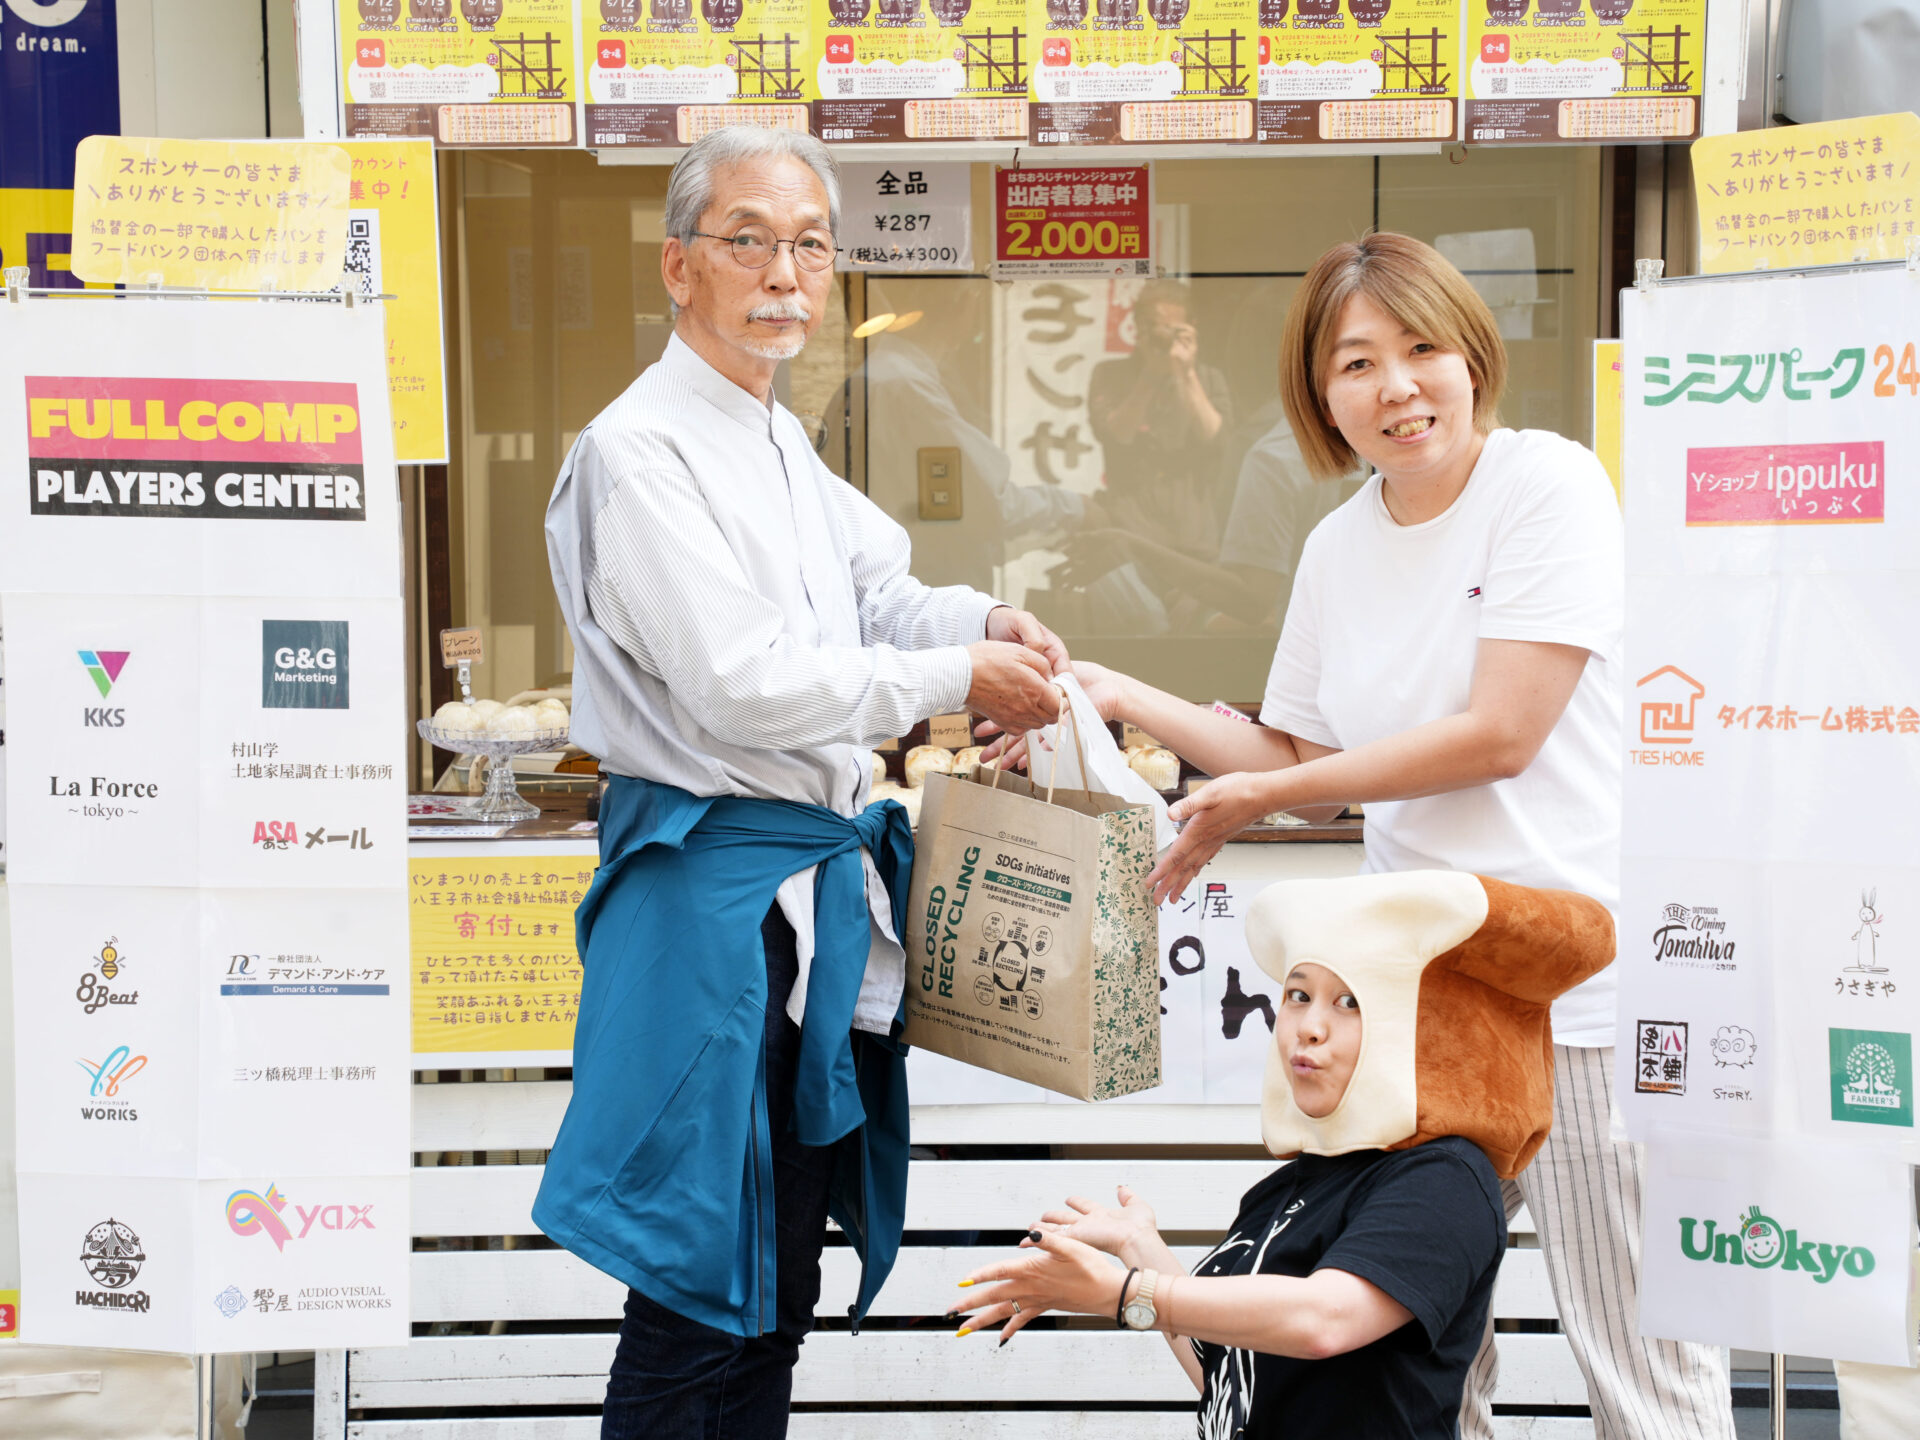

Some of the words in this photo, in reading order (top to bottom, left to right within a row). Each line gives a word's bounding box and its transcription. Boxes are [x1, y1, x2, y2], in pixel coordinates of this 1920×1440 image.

[16, 32, 86, 53] dream.
[1731, 136, 1883, 168] スポンサーの皆さま
[119, 158, 302, 183] スポンサーの皆さま
[1008, 171, 1136, 182] はちおうじチャレンジショップ
[876, 170, 928, 195] 全品
[1007, 184, 1137, 206] 出店者募集中
[874, 214, 931, 232] ¥287
[1716, 198, 1913, 231] 協賛金の一部で購入したパンを
[90, 219, 328, 244] 協賛金の一部で購入したパンを
[1719, 221, 1914, 250] フードバンク団体へ寄付します
[90, 242, 326, 265] フードバンク団体へ寄付します
[850, 247, 957, 264] (税込み¥300)
[30, 398, 358, 444] FULLCOMP
[1691, 470, 1760, 492] Yショップ
[1768, 451, 1877, 498] ippuku
[37, 470, 205, 506] PLAYERS
[215, 473, 362, 509] CENTER
[1782, 495, 1862, 514] いっぷく
[445, 636, 478, 647] プレーン
[275, 647, 337, 669] G&G
[274, 671, 337, 685] Marketing
[84, 708, 125, 727] KKS
[231, 742, 279, 758] 村山学
[1662, 750, 1704, 766] HOME
[231, 763, 393, 780] 土地家屋調査士事務所
[49, 776, 81, 797] La
[91, 777, 159, 799] Force
[83, 804, 124, 820] tokyo
[252, 821, 298, 845] ASA
[305, 827, 374, 850] メール
[995, 853, 1023, 872] SDGs
[1025, 861, 1071, 885] initiatives
[413, 890, 584, 906] 八王子市社会福祉協議会
[938, 845, 981, 999] RECYCLING
[1665, 906, 1686, 921] THE
[1693, 907, 1718, 915] OUTDOOR
[1691, 914, 1726, 934] Dining
[454, 911, 560, 940] 寄付します
[922, 885, 947, 992] CLOSED
[1653, 924, 1735, 962] Tonariwa
[268, 955, 322, 964] 一般社団法人
[268, 967, 386, 981] デマンド・アンド・ケア
[1835, 978, 1897, 998] うさぎや
[233, 1066, 376, 1082] 三ツ橋税理士事務所
[1851, 1095, 1894, 1105] FARMER'S
[81, 1107, 138, 1121] WORKS
[295, 1204, 376, 1239] yax
[75, 1290, 150, 1313] HACHIDORI
[252, 1287, 293, 1313] 響屋
[298, 1287, 338, 1298] AUDIO
[341, 1286, 386, 1297] VISUAL
[298, 1299, 343, 1311] DESIGN
[346, 1299, 392, 1310] WORKS
